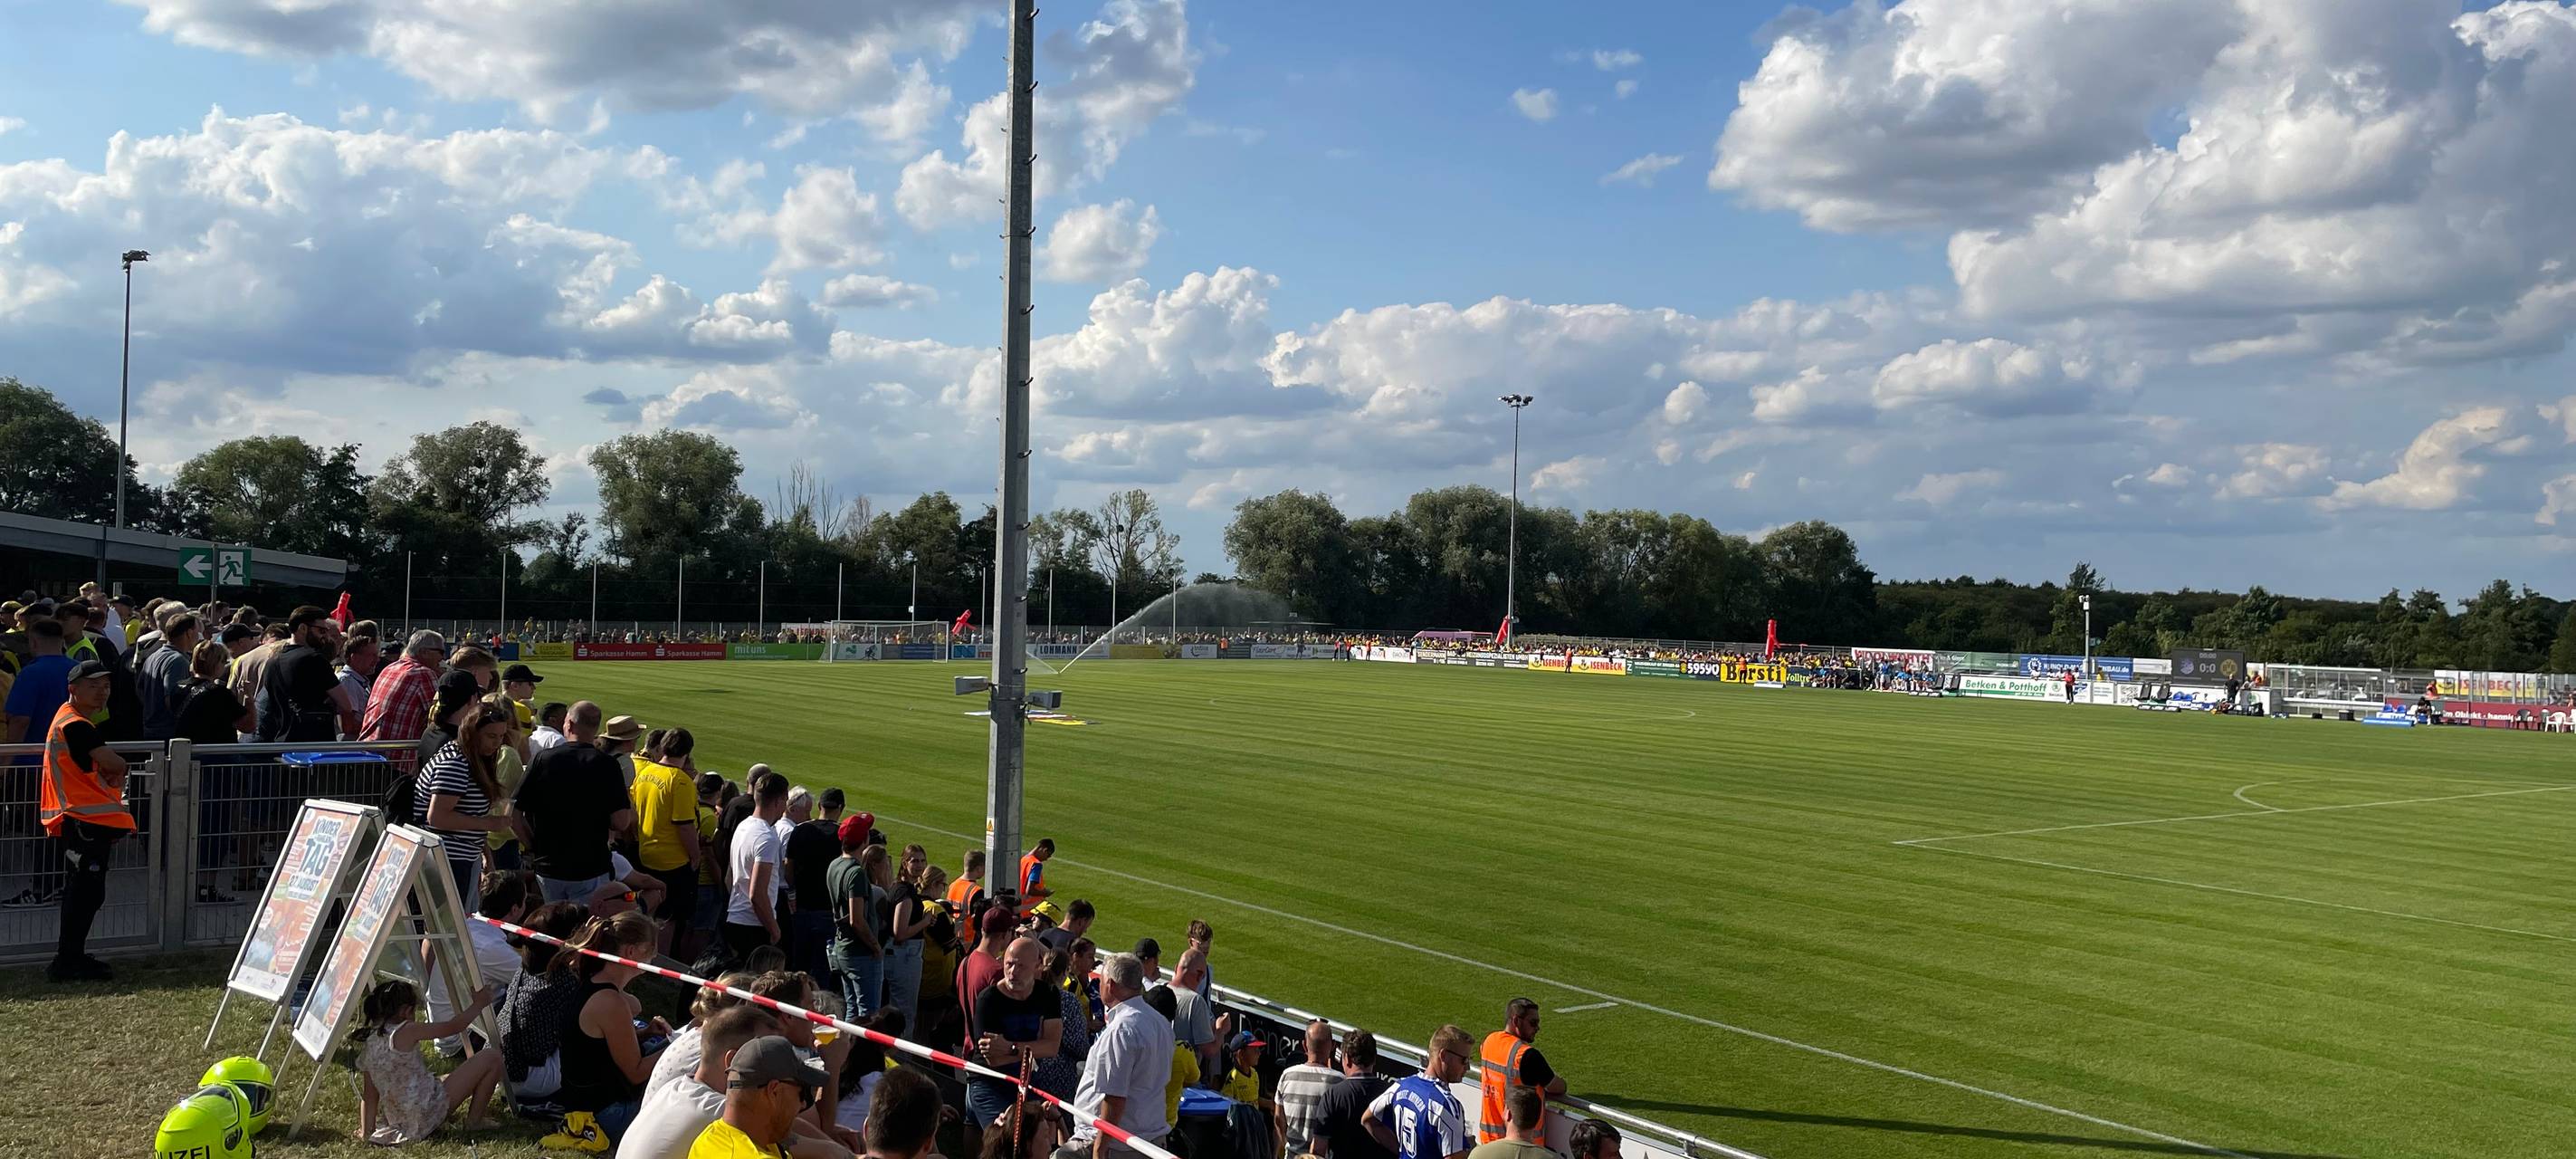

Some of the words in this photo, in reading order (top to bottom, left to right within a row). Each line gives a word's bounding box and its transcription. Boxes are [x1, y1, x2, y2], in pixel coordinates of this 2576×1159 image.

[590, 650, 625, 658] Sparkasse
[667, 650, 701, 658] Sparkasse
[1039, 645, 1078, 655] LOHMANN
[1542, 659, 1569, 668] ISENBEC
[1590, 660, 1623, 671] ISENBECK
[1687, 662, 1720, 675] 59590
[2199, 662, 2217, 674] 0:0
[1726, 664, 1781, 682] Brsti
[1965, 679, 1997, 689] Betken
[1999, 680, 2007, 690] &
[2008, 681, 2048, 693] Potthoff
[314, 819, 342, 837] KINDER
[299, 838, 336, 877] TAG
[368, 868, 396, 915] TAG
[1394, 1103, 1417, 1158] 15
